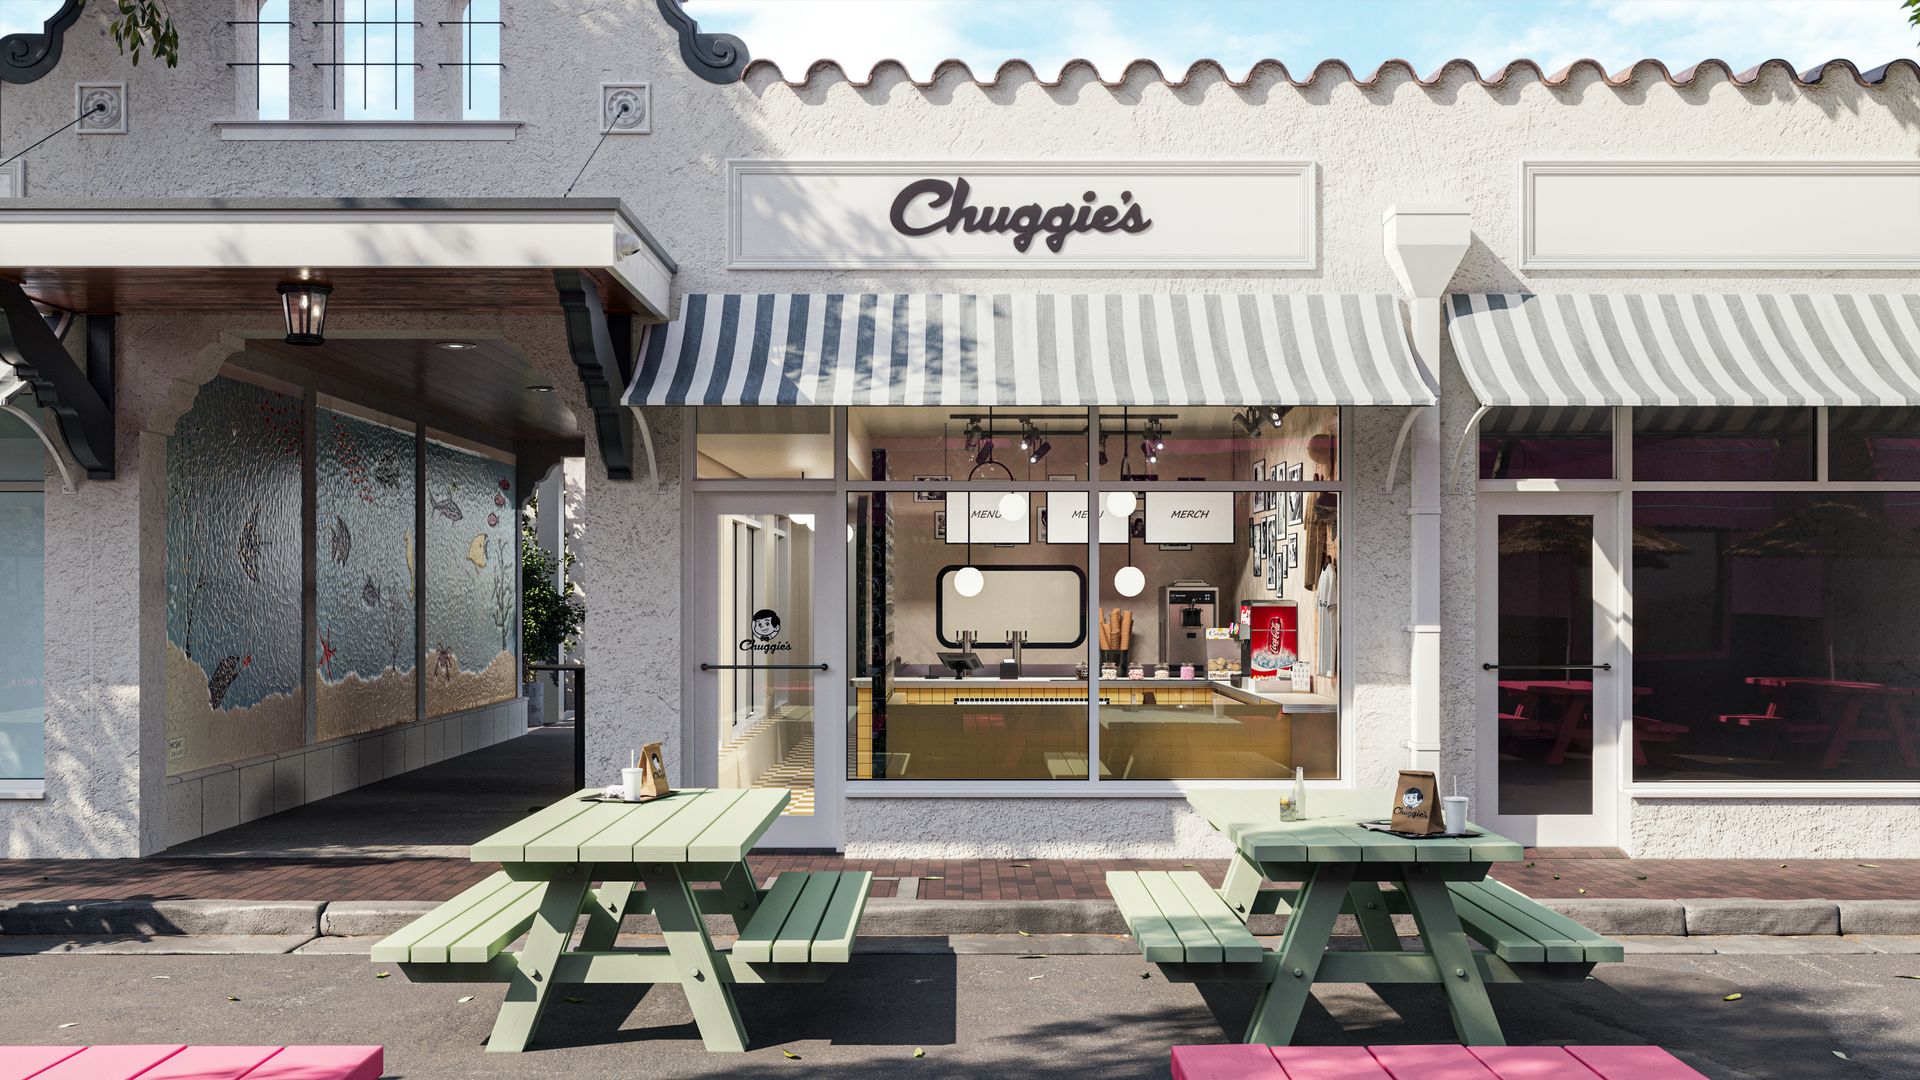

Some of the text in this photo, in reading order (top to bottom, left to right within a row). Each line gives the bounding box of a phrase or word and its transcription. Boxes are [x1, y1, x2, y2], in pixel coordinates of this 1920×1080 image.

[889, 176, 1152, 253] Chuggie's
[1170, 509, 1210, 519] MERCH
[740, 639, 792, 654] Chuggie's
[1393, 807, 1428, 819] Chuggie's
